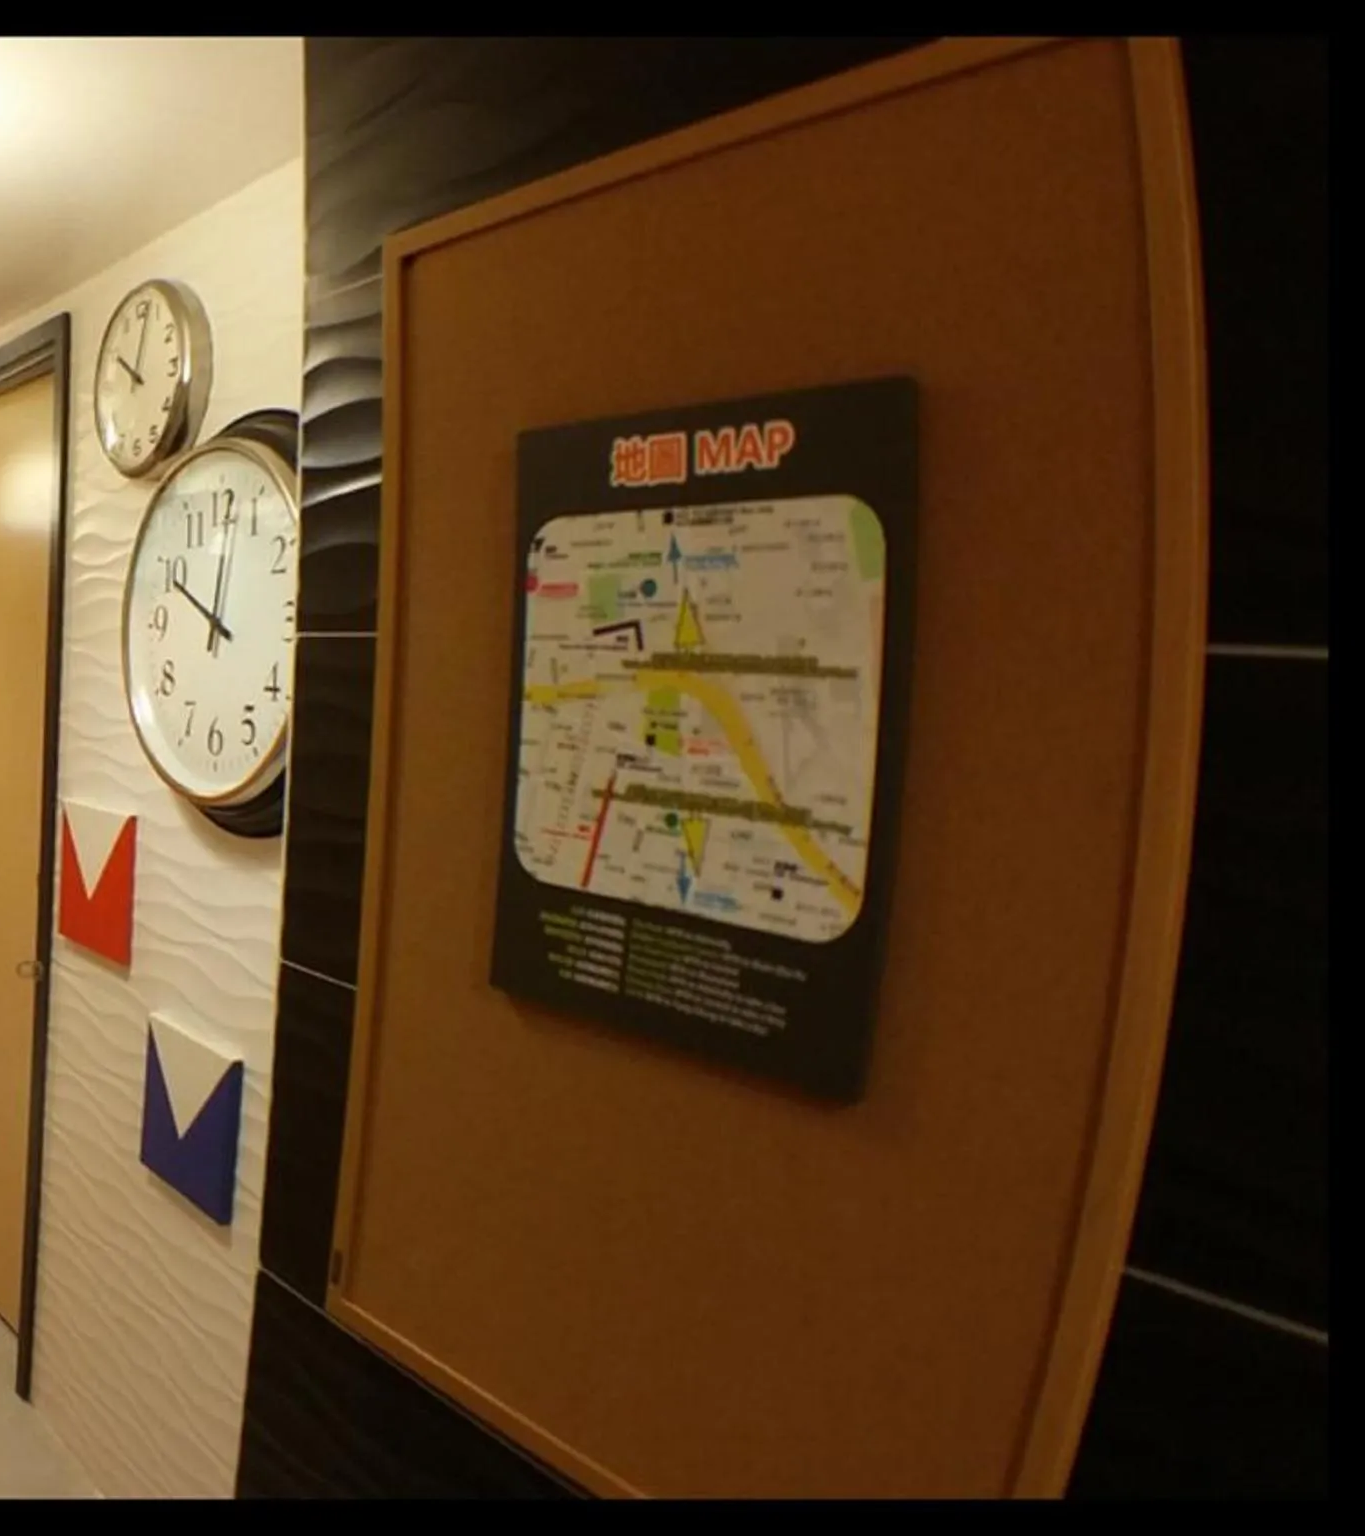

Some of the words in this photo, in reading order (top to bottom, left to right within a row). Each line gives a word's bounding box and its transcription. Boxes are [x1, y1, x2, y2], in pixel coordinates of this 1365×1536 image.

[164, 323, 176, 343] 2
[167, 356, 179, 377] 3
[149, 424, 159, 444] 5
[611, 433, 688, 487] 地圖
[695, 420, 795, 475] MAP
[212, 488, 238, 528] 12
[250, 497, 258, 537] 1
[186, 511, 204, 549] 11
[270, 535, 288, 575] 2
[164, 556, 188, 594] 10
[154, 604, 169, 642] 9
[160, 659, 176, 697] 8
[263, 661, 282, 702] 4
[184, 701, 197, 737] 7
[207, 716, 224, 757] 6
[241, 704, 257, 746] 5
